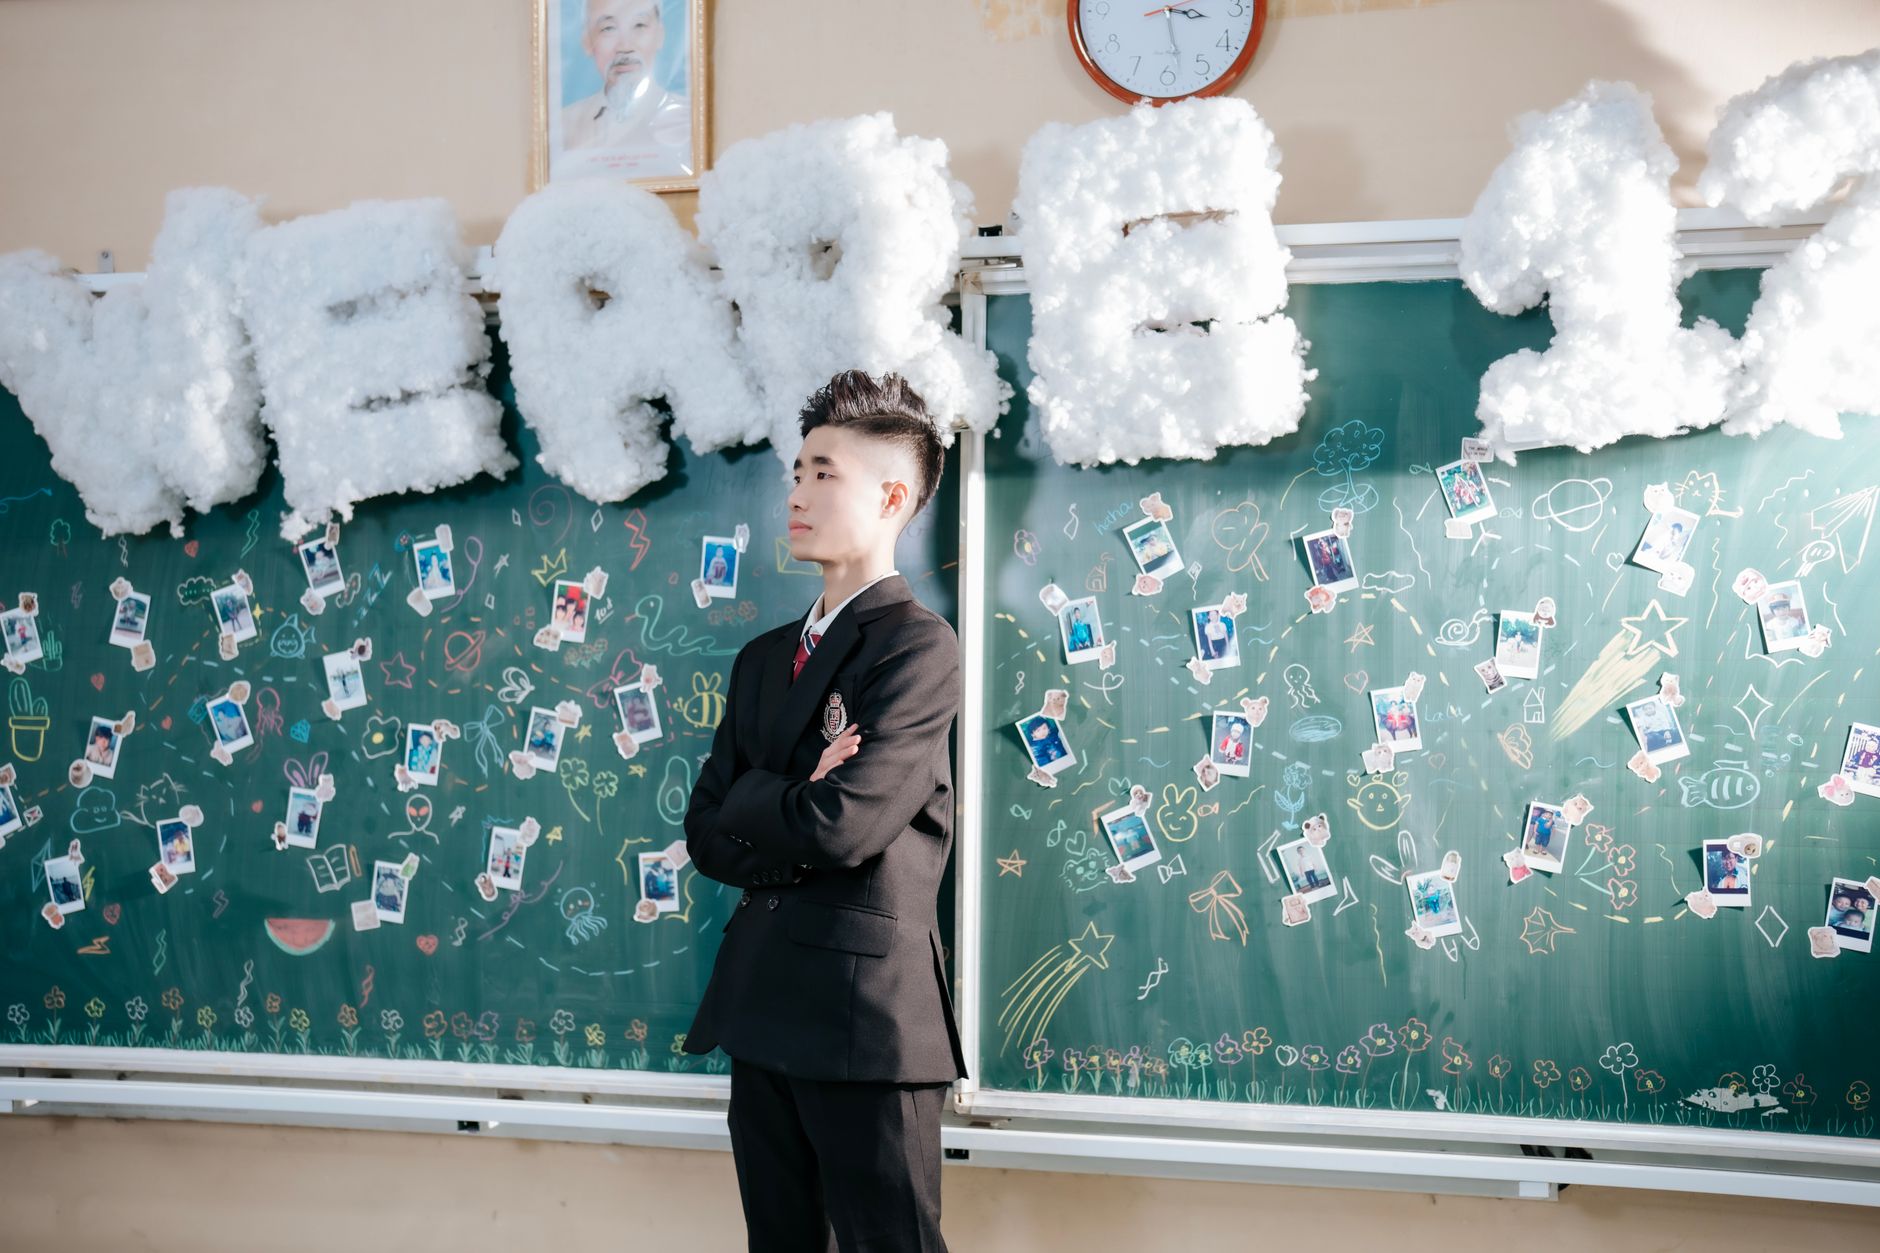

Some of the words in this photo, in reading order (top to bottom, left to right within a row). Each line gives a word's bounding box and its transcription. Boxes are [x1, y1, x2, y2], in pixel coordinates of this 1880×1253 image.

[1227, 0, 1243, 18] 3
[1104, 33, 1120, 54] 8
[1215, 28, 1231, 52] 4
[1129, 55, 1142, 76] 7
[1194, 53, 1211, 76] 5
[1159, 65, 1177, 86] 6
[0, 186, 517, 538] WE
[495, 97, 1318, 503] ARE
